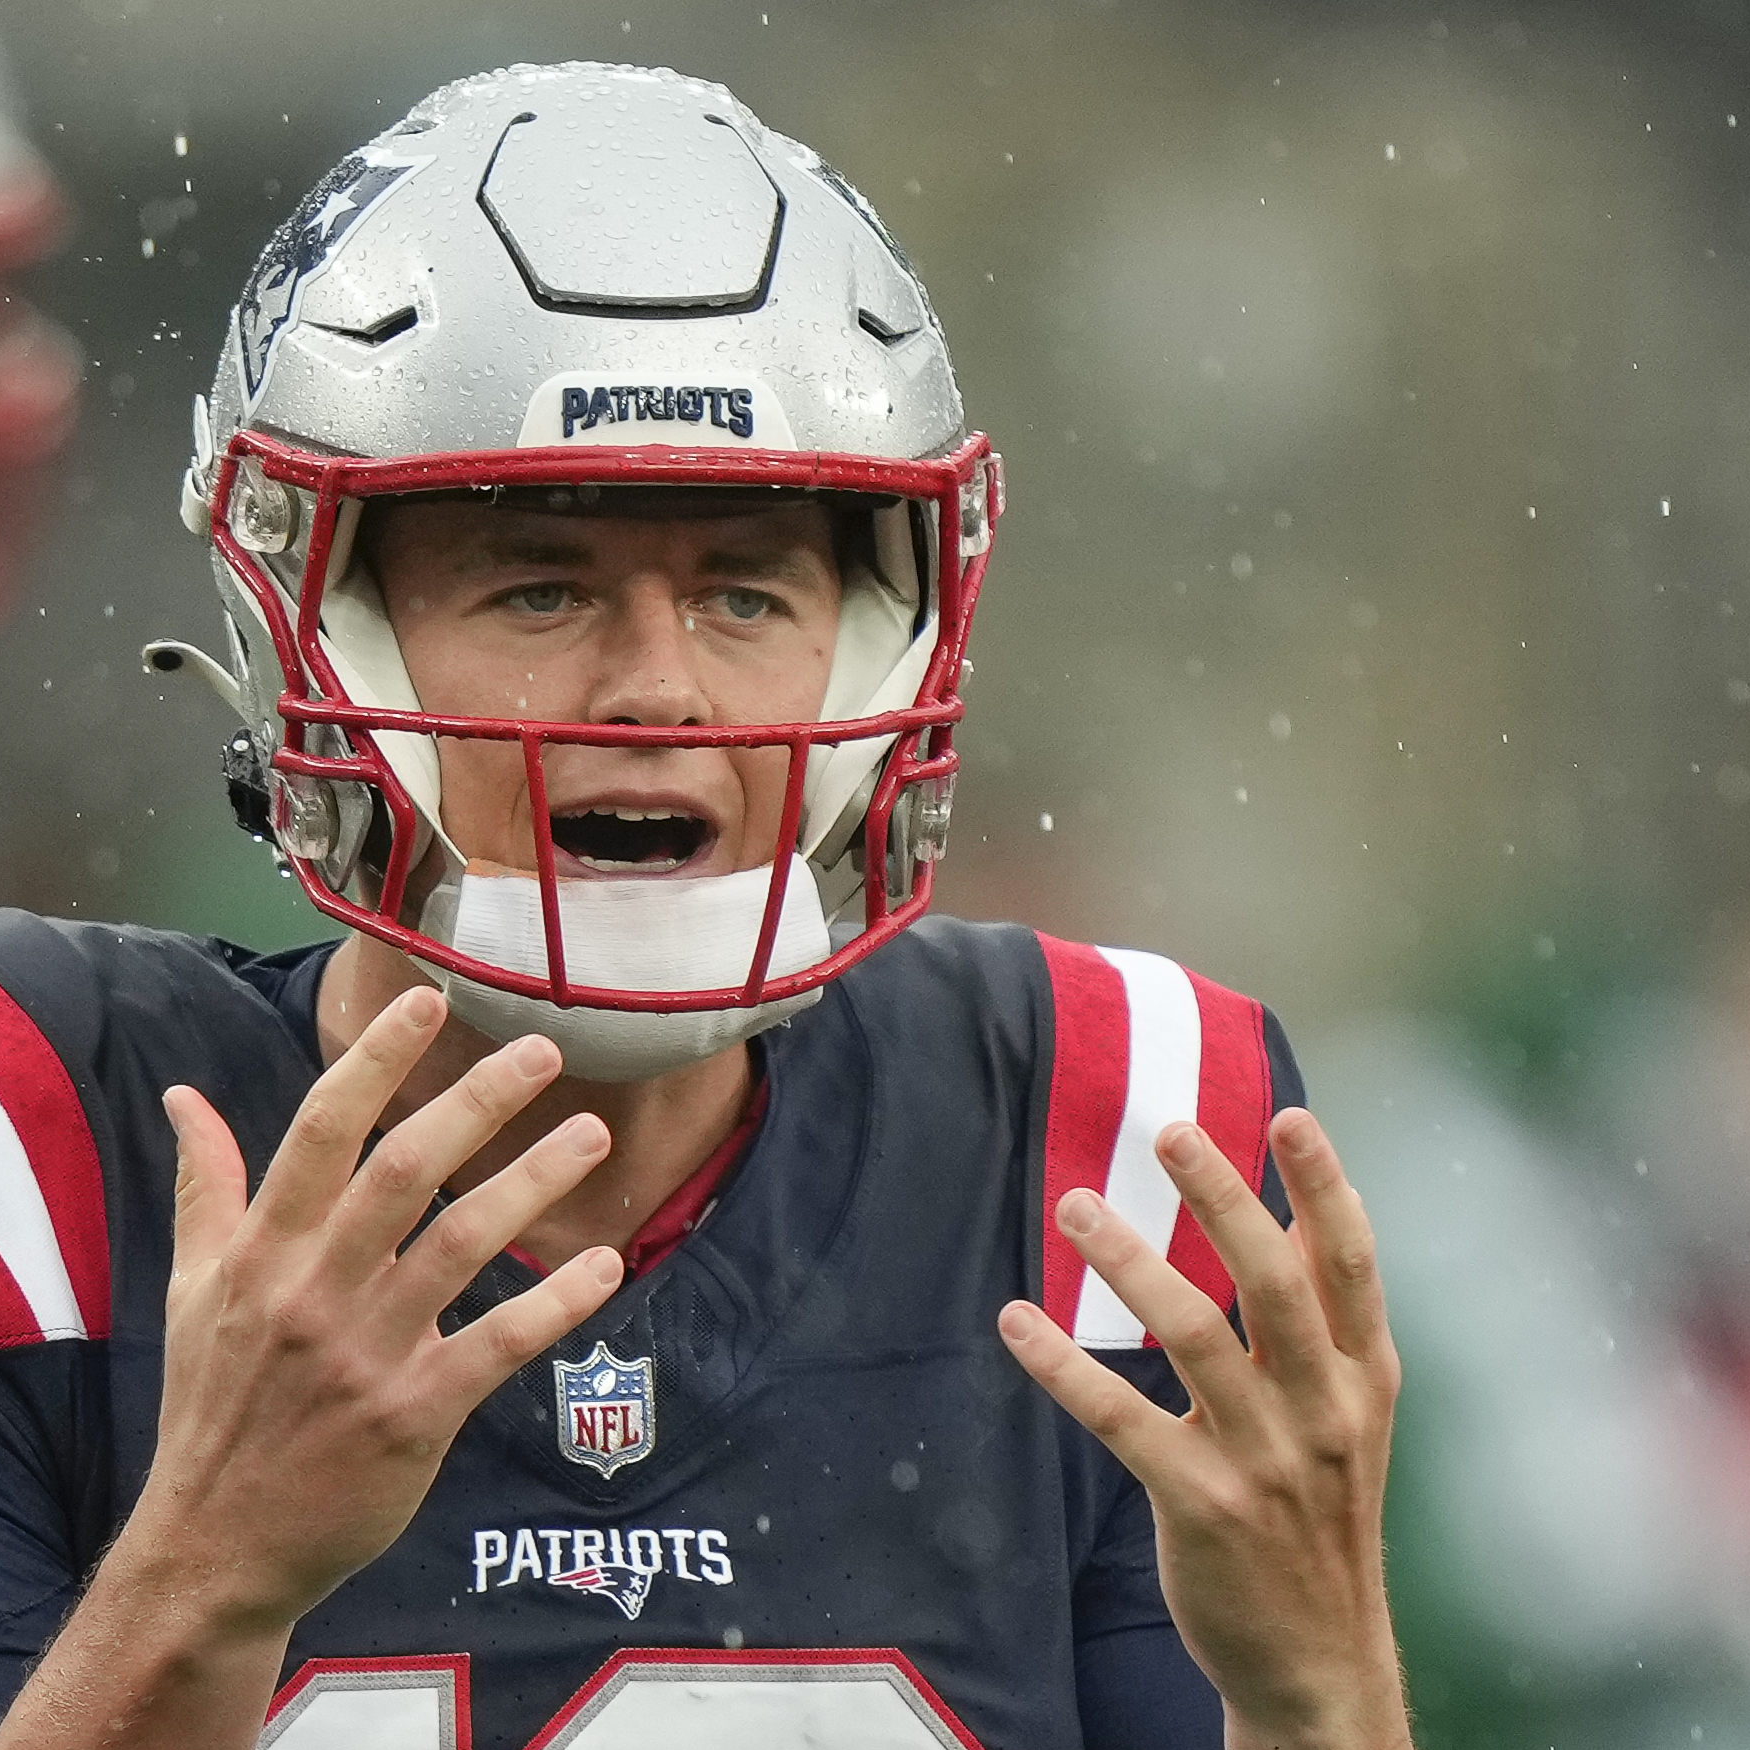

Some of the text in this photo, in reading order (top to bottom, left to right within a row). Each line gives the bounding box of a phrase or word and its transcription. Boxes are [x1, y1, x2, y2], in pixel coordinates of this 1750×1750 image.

[562, 386, 754, 438] PATRIOTS
[574, 1405, 642, 1454] NFL
[471, 1528, 735, 1594] PATRIOTS
